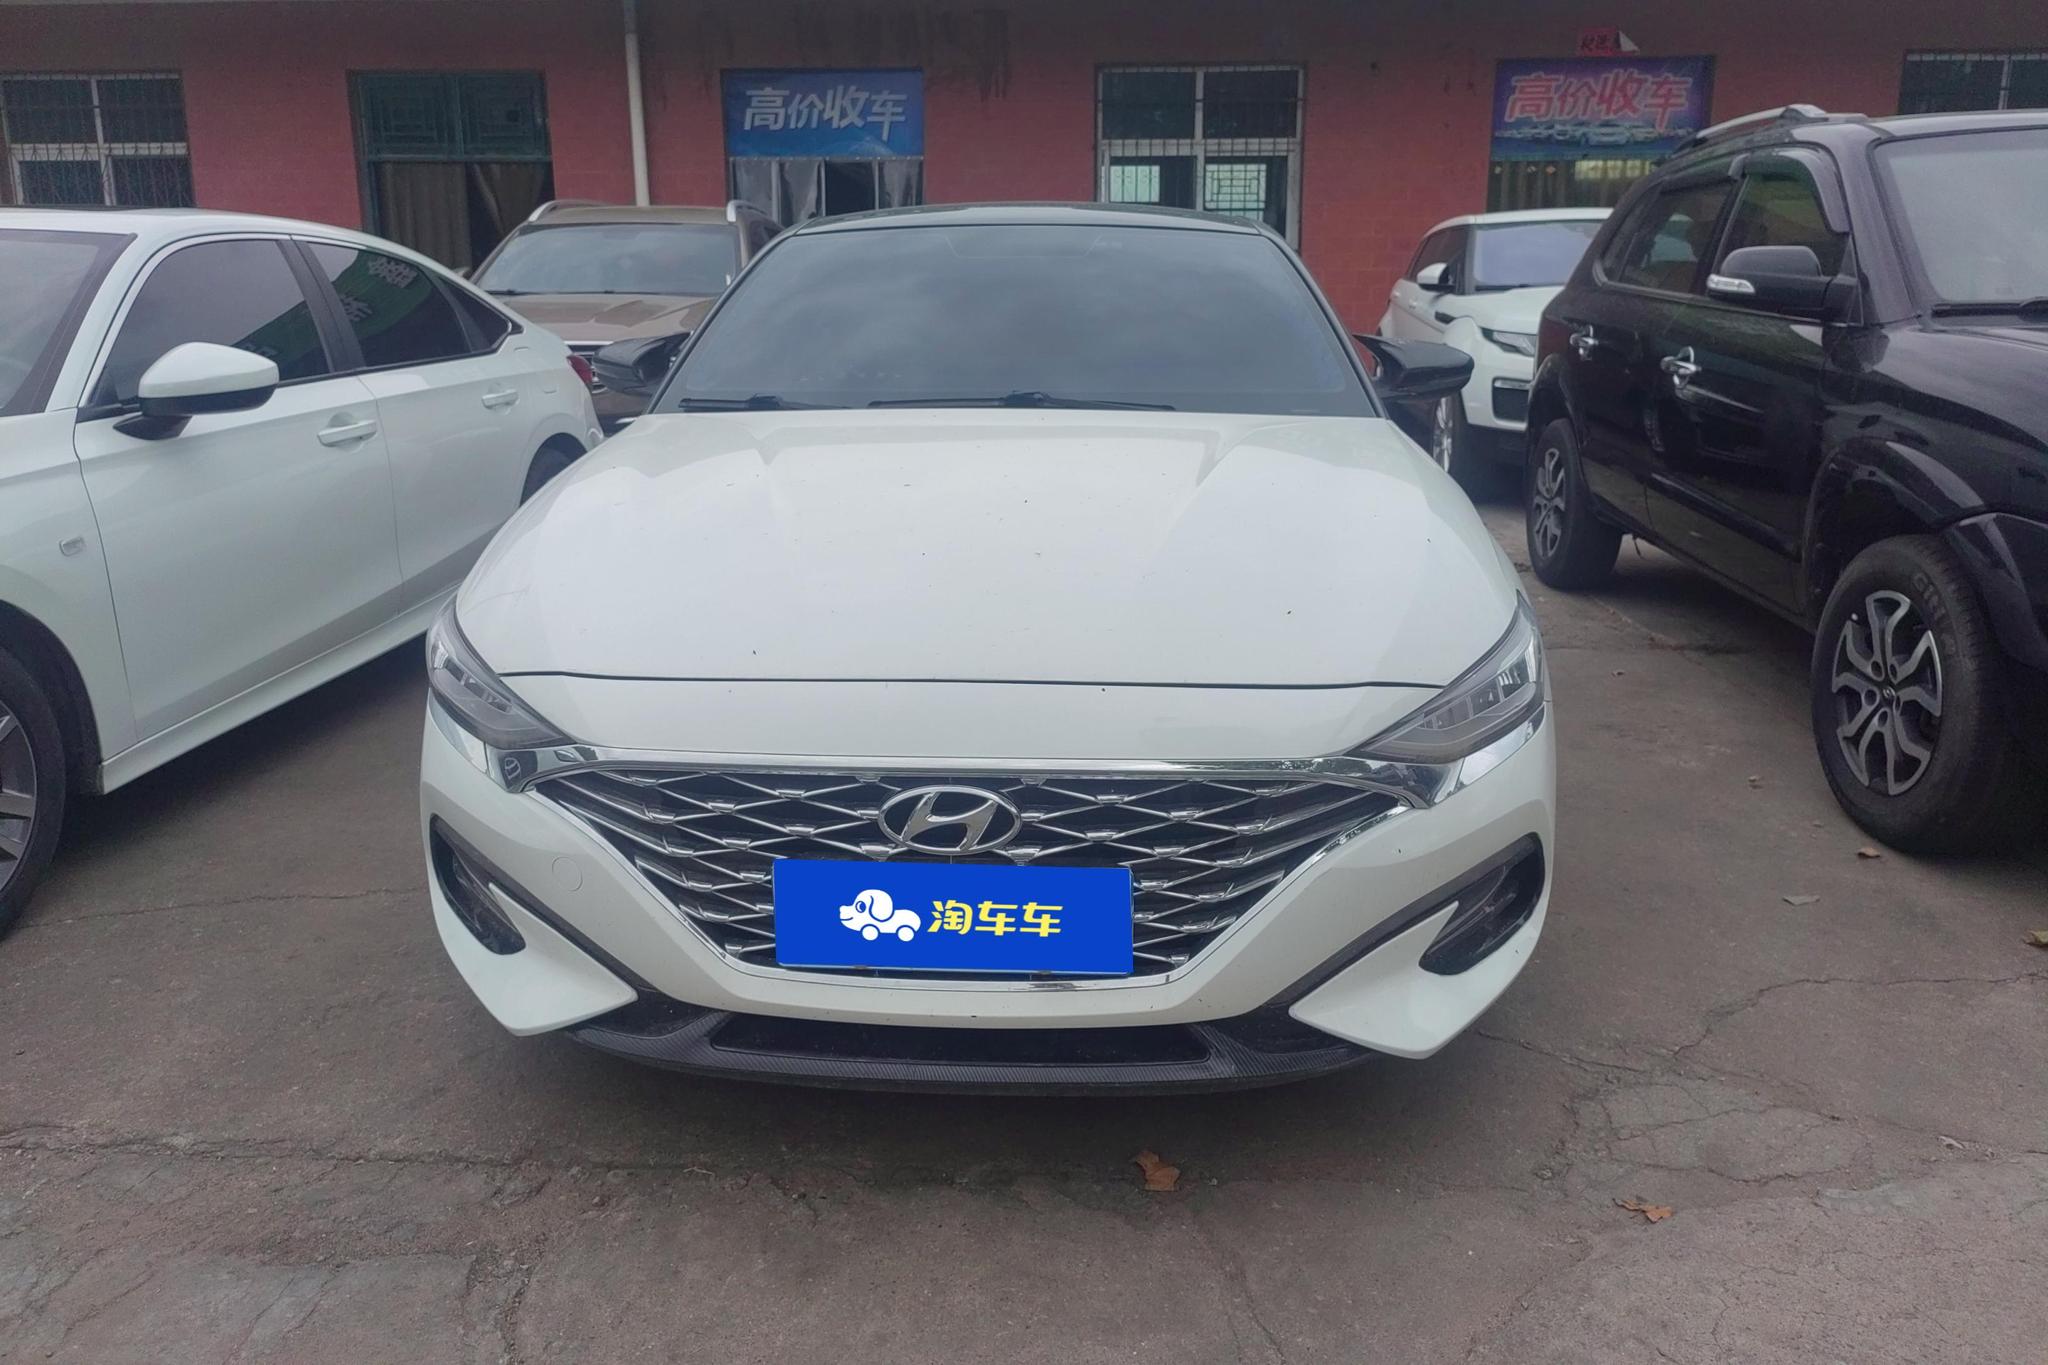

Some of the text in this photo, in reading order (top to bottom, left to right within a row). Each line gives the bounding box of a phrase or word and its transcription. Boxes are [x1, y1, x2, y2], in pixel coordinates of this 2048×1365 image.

[743, 85, 908, 142] 高价收车
[1505, 68, 1693, 132] 高价收车
